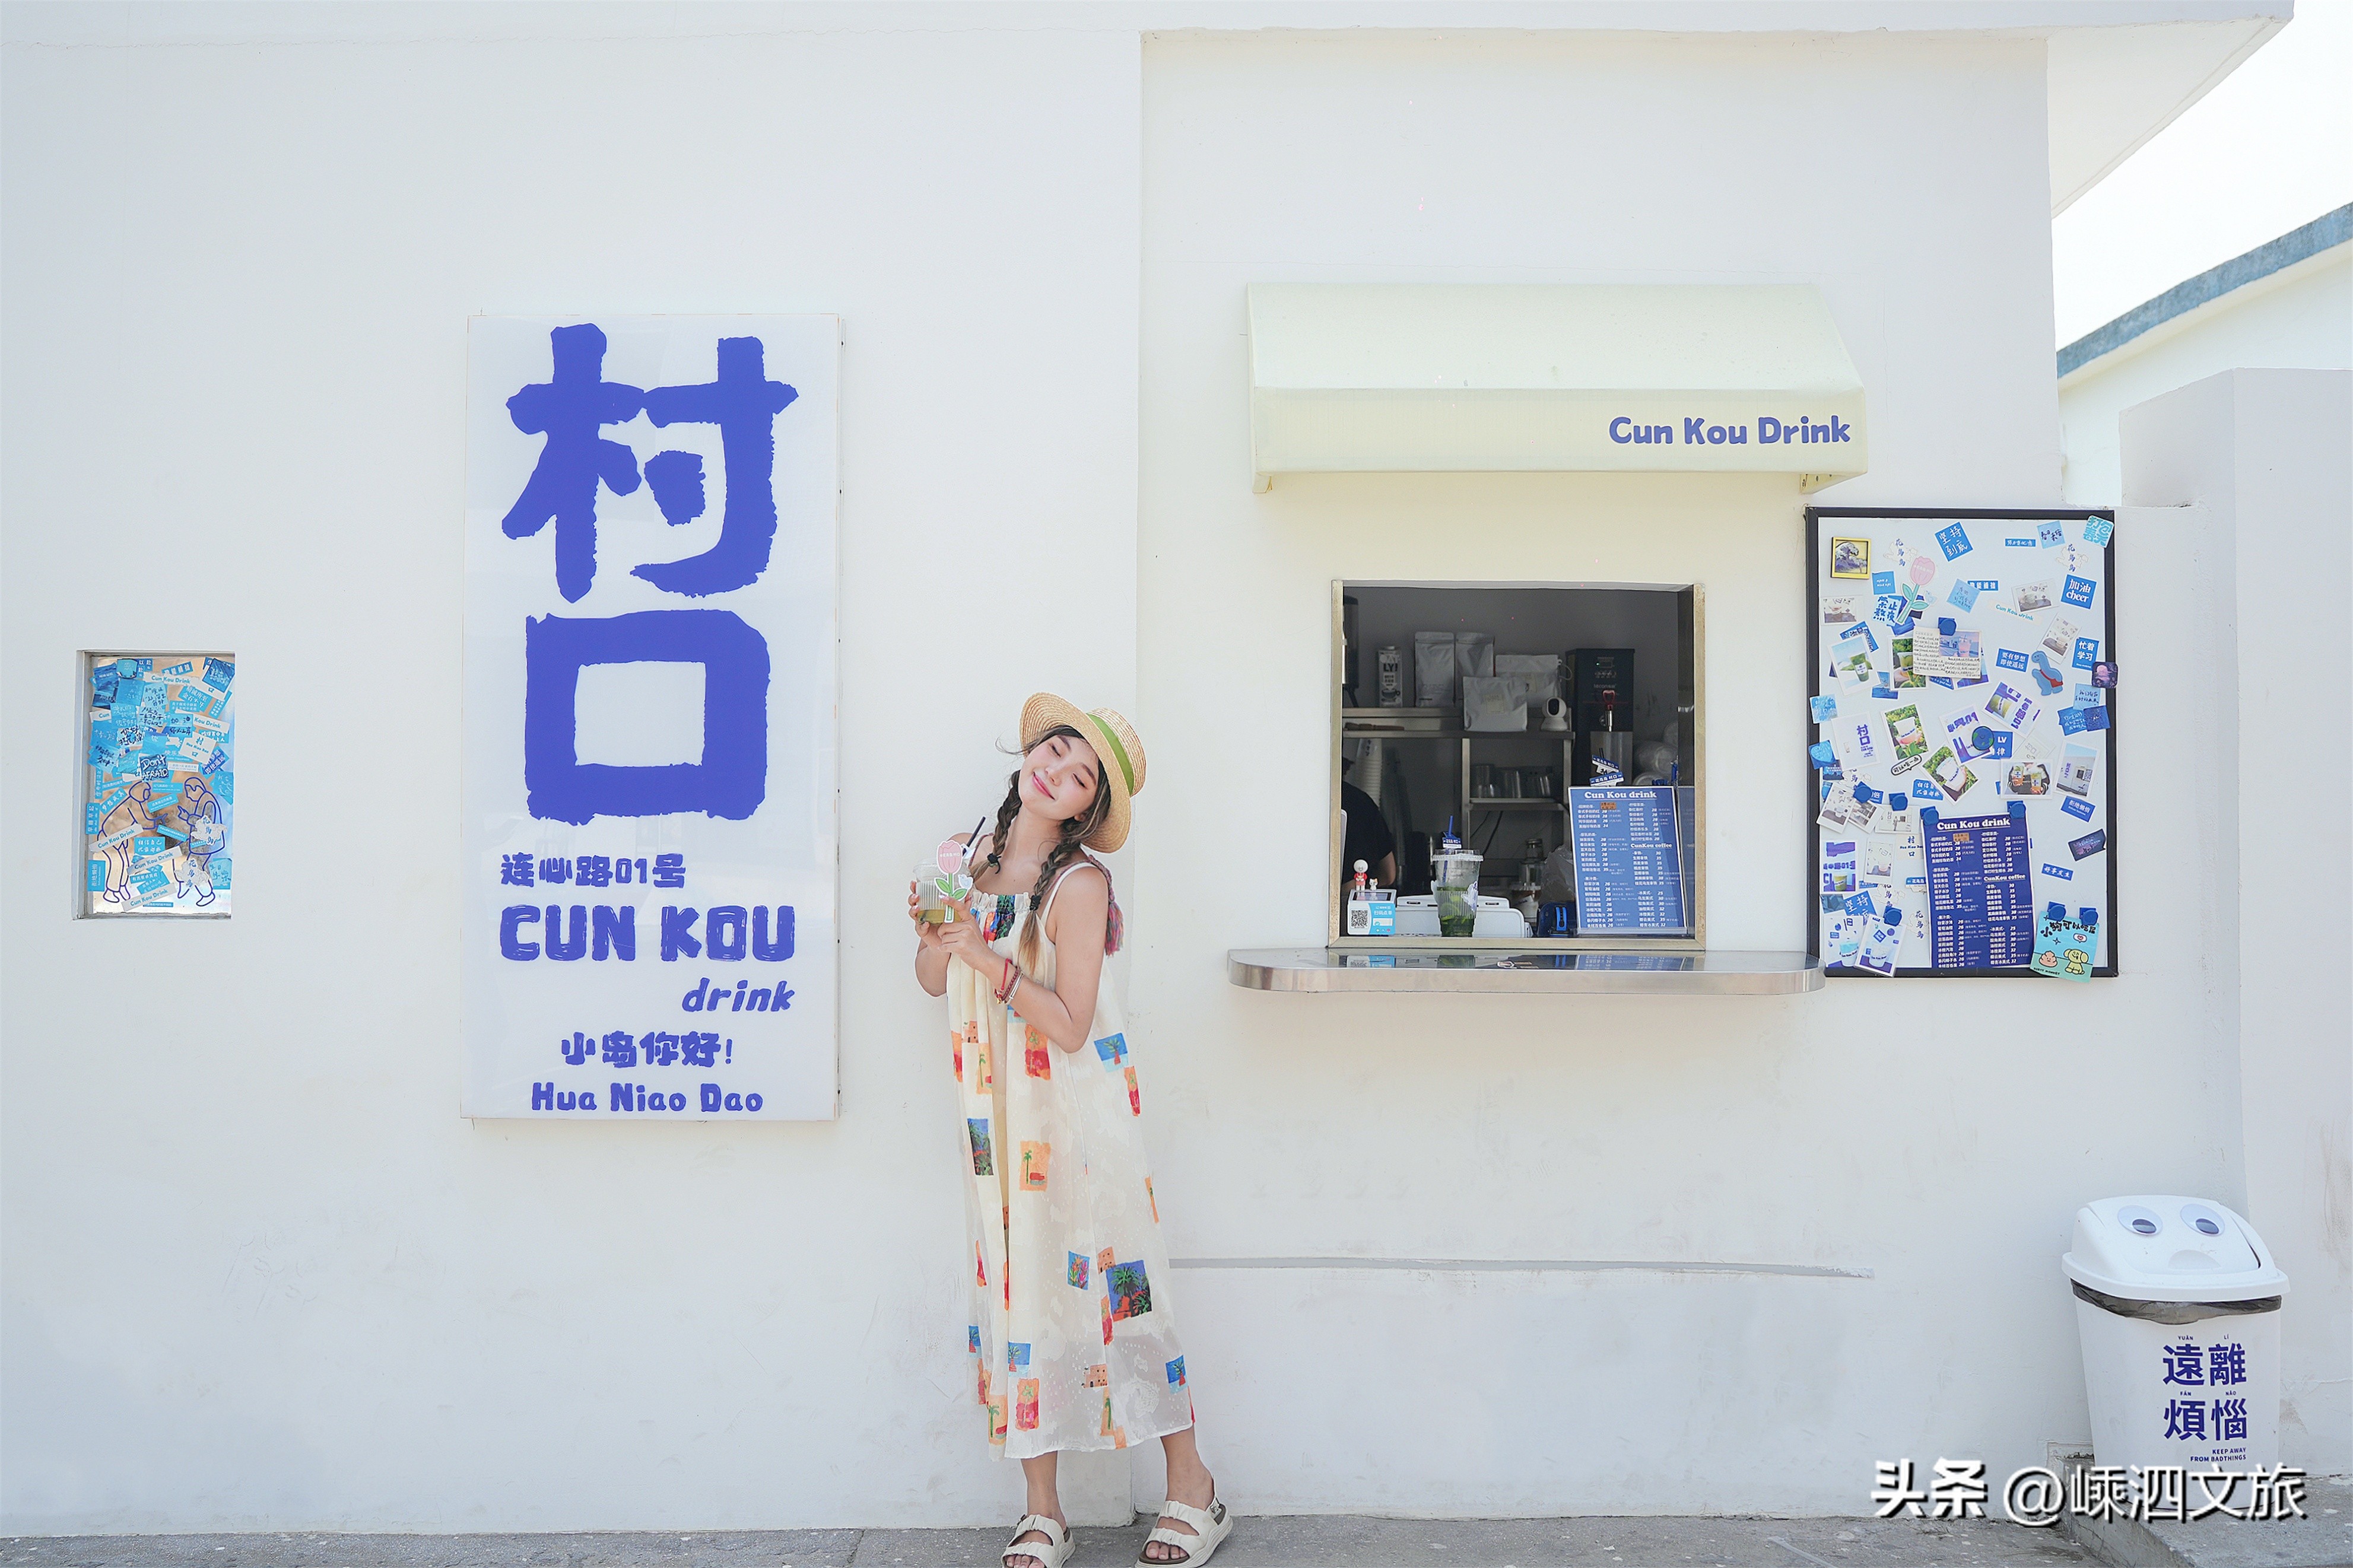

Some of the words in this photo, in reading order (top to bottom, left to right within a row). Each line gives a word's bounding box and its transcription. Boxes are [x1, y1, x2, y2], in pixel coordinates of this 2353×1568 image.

[1609, 416, 1674, 444] Cun
[1684, 416, 1747, 444] Kou
[1758, 415, 1850, 444] Drink
[1939, 526, 1961, 545] 坚持
[1945, 540, 1968, 556] 到底
[2069, 578, 2091, 593] 加油
[2066, 590, 2090, 603] cheer
[1996, 604, 2006, 612] Cun
[2079, 641, 2095, 651] 忙着
[2077, 651, 2093, 661] 学习
[205, 720, 221, 729] Drink
[1857, 724, 1871, 746] 村口
[1982, 818, 2011, 826] drink
[120, 829, 135, 839] Drink
[158, 852, 173, 861] Drink
[500, 853, 686, 888] 连心路01号
[153, 888, 169, 898] Drink
[1845, 895, 1868, 912] 坚持
[500, 905, 636, 961] CUN
[661, 905, 795, 961] KOU
[682, 978, 794, 1012] drink
[531, 1082, 597, 1111] Hua
[610, 1082, 687, 1111] Niao
[700, 1083, 763, 1112] Dao
[2163, 1343, 2247, 1386] 遠離
[2164, 1398, 2247, 1441] 煩惱
